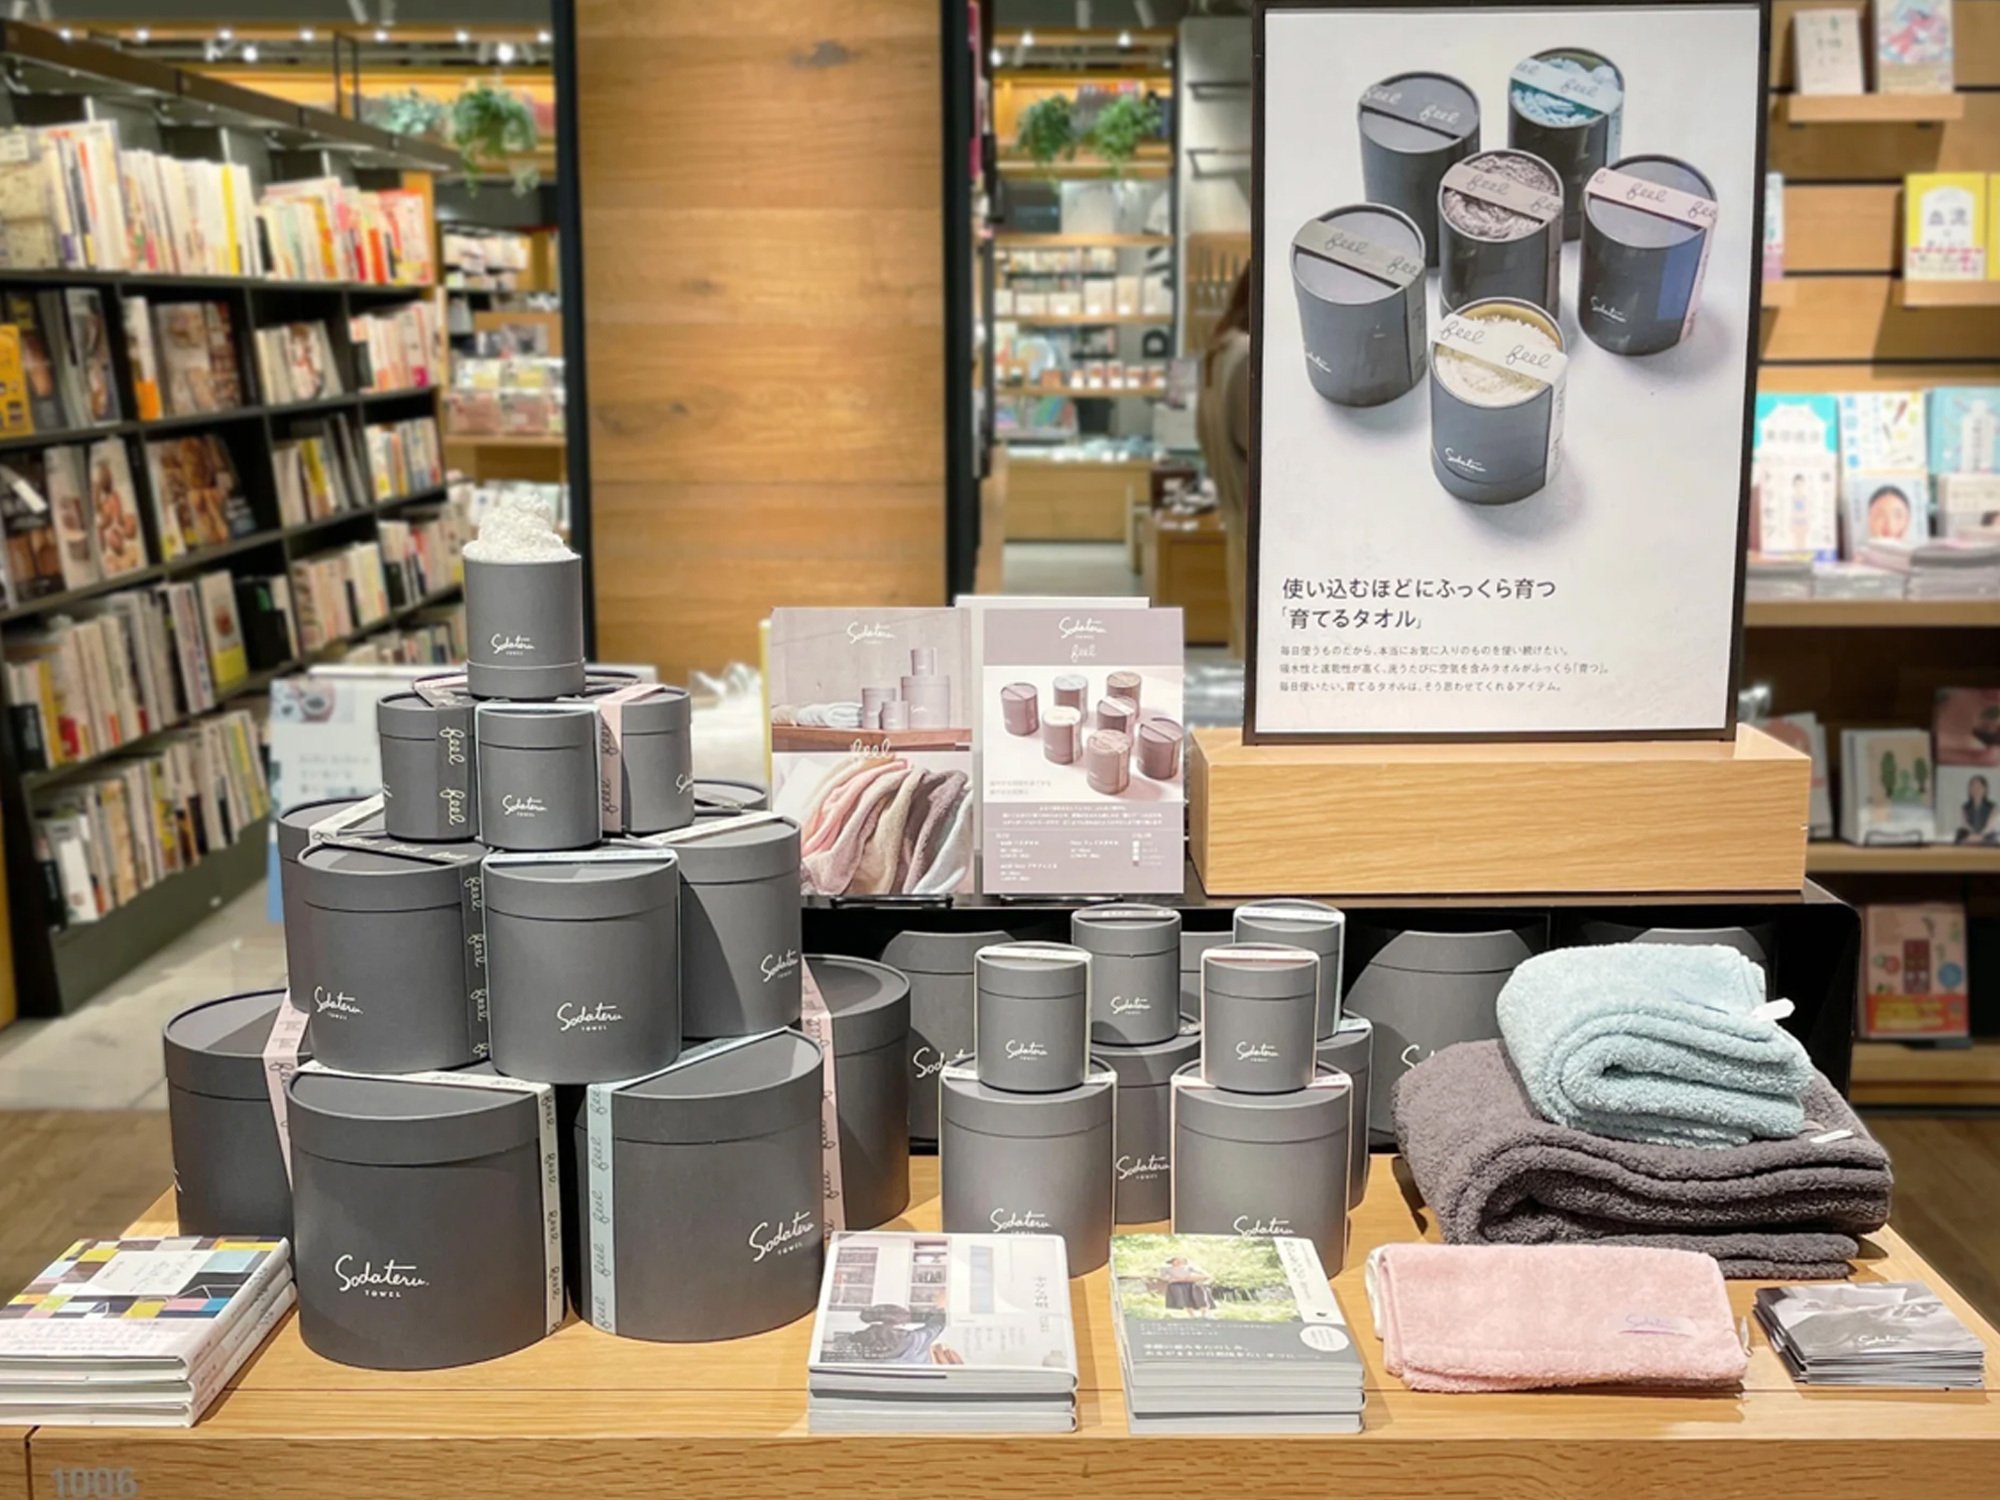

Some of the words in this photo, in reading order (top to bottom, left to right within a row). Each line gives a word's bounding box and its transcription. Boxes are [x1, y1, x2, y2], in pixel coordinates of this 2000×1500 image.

[1466, 174, 1510, 196] feel
[1626, 182, 1668, 203] feel
[1687, 201, 1717, 220] fee
[1324, 232, 1369, 255] feel
[1385, 256, 1418, 276] fee
[1439, 321, 1486, 345] feel
[1505, 345, 1553, 369] feel
[1282, 577, 1557, 600] 使い込むほどにふっくら育つ
[1281, 606, 1422, 630] 「育てるタオル」
[440, 727, 465, 766] feel
[440, 788, 465, 827] feel
[556, 1002, 623, 1031] Sodateru
[748, 1211, 815, 1263] Sodateru
[989, 1208, 1051, 1234] Sodateru
[334, 1254, 430, 1292] Sodateru
[365, 1290, 401, 1298] TOWEL
[53, 1465, 138, 1500] 1006
